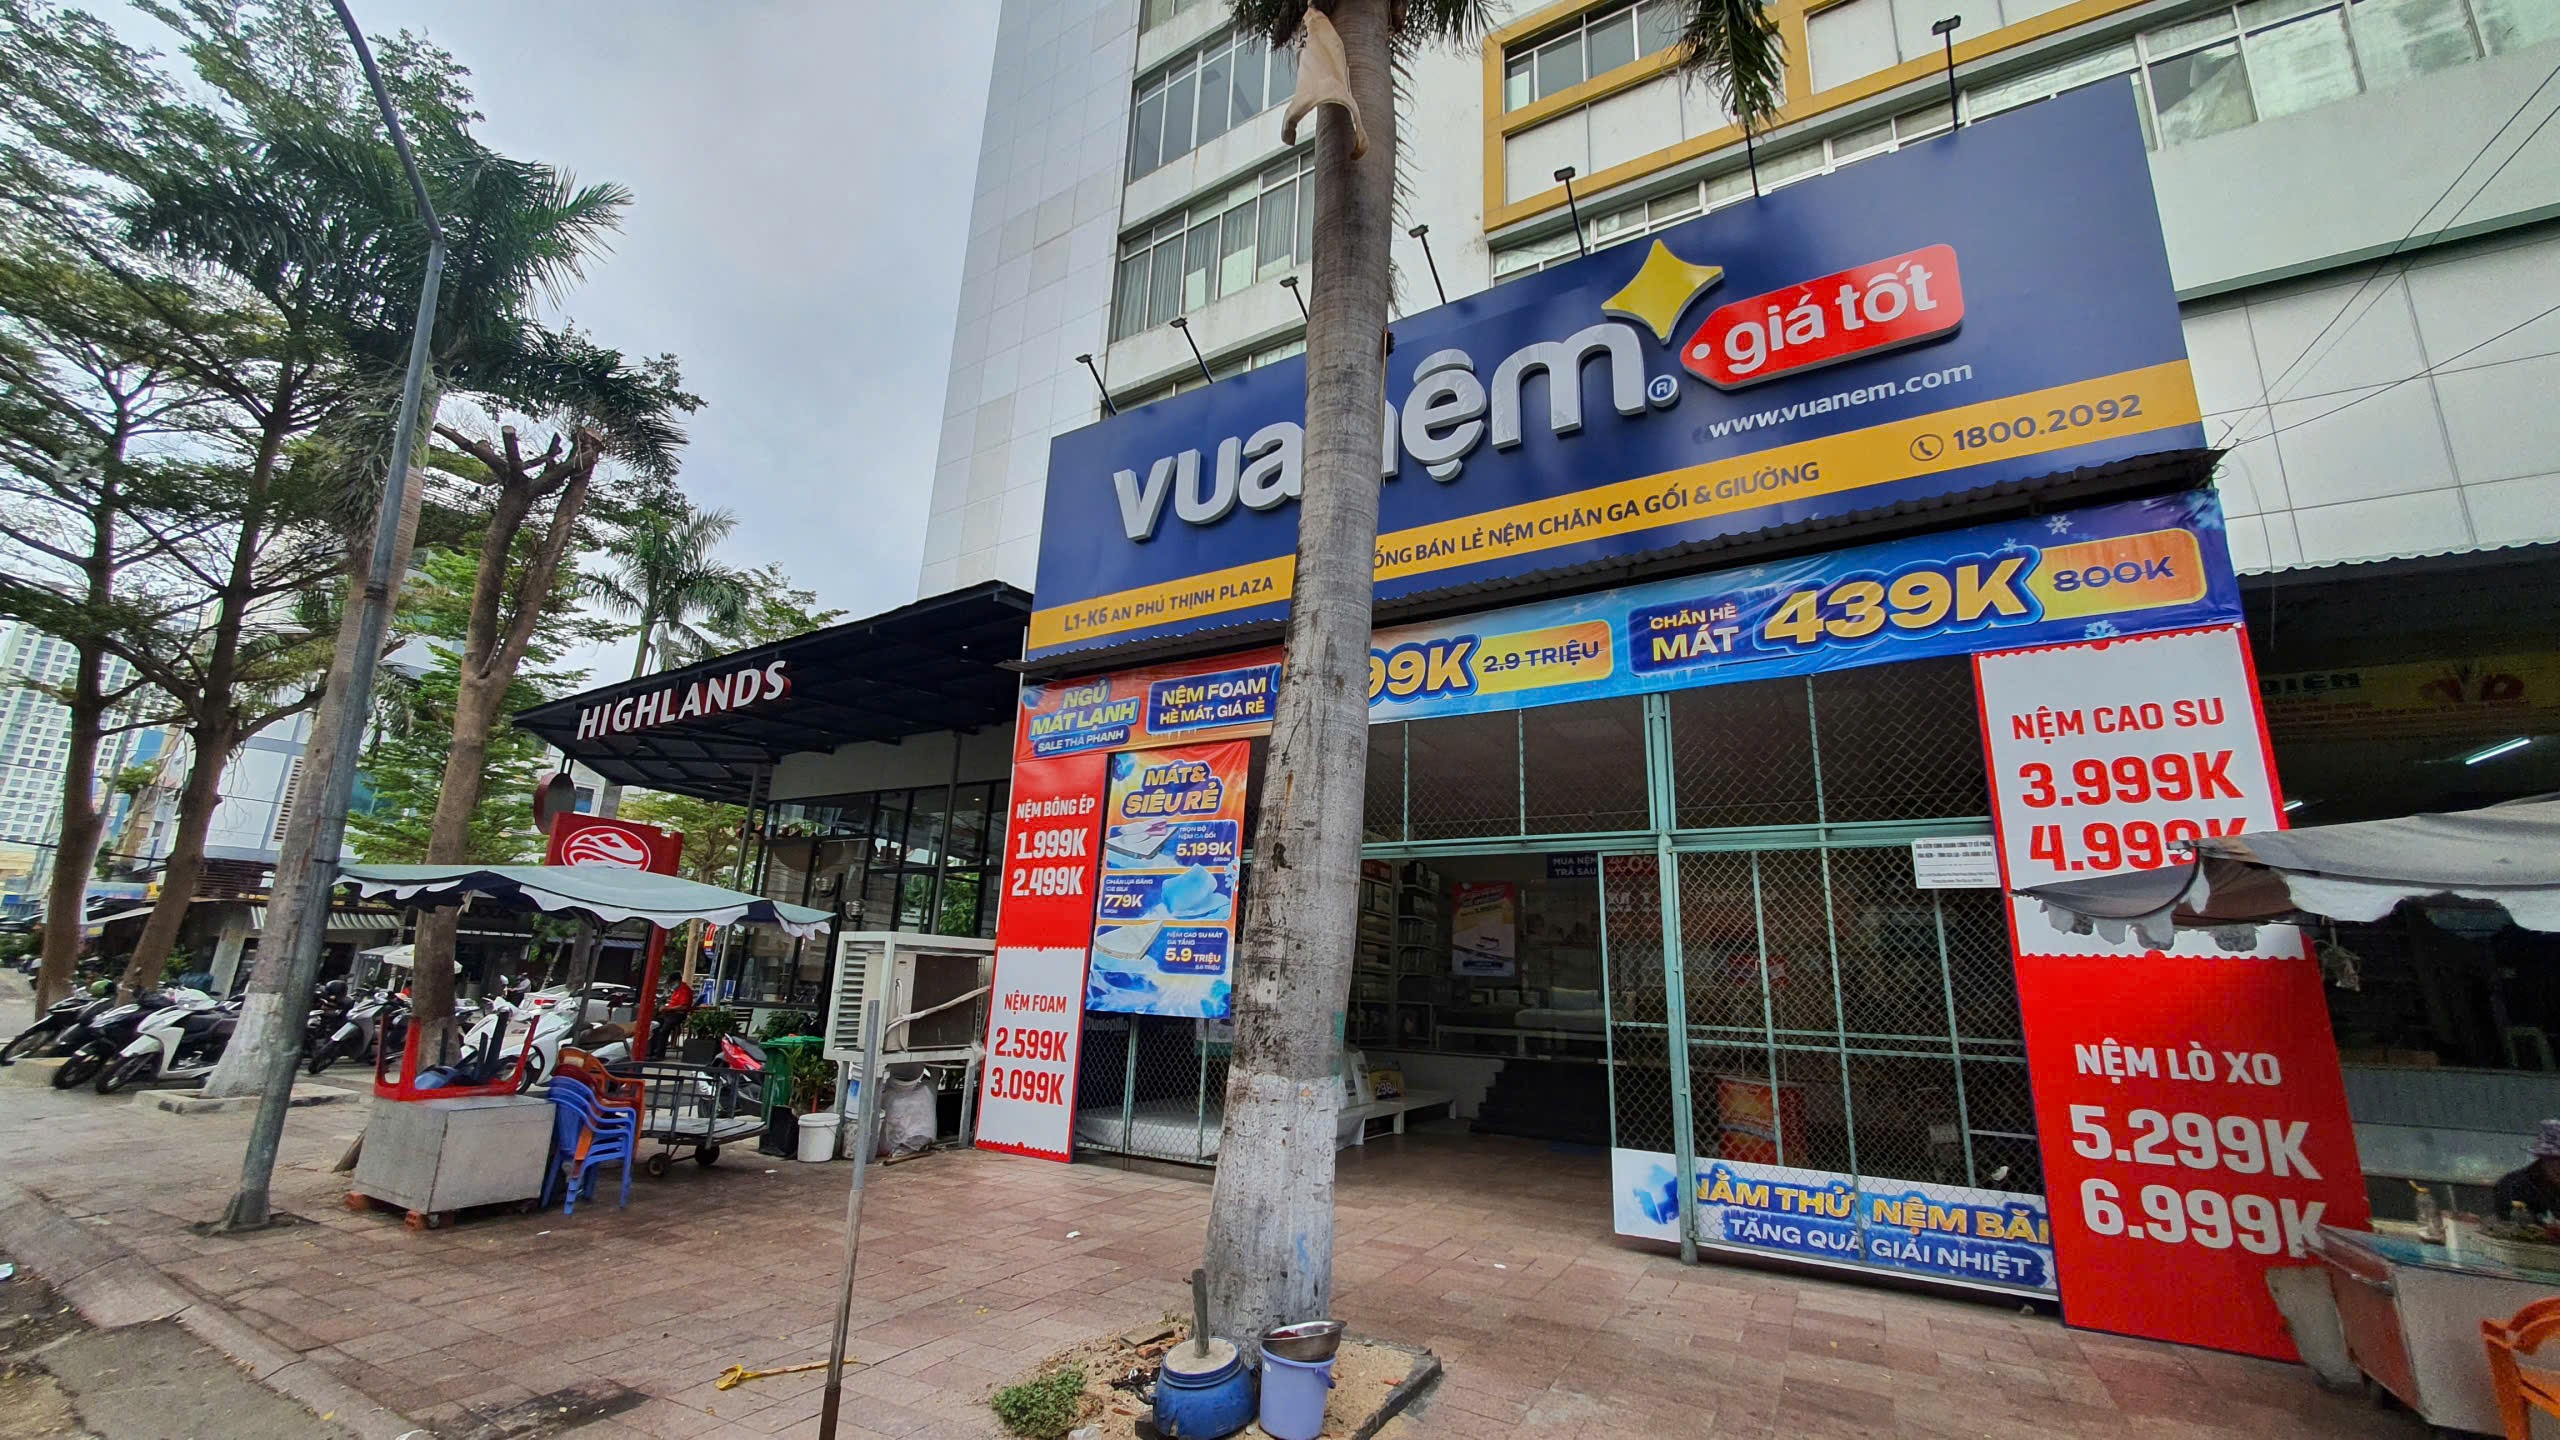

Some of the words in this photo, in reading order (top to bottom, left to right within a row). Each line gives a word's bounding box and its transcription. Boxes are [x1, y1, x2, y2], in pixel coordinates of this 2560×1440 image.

[1723, 291, 1826, 375] giá
[1837, 259, 1938, 331] tốt
[1708, 363, 1973, 440] www.vuanem.com
[1952, 394, 2143, 452] 1800.2092
[1415, 537, 1455, 561] BÁN
[1461, 526, 1484, 551] LẺ
[1488, 521, 1533, 546] NỆM
[1538, 504, 1602, 535] CHĂN
[1607, 502, 1640, 523] GA
[1644, 483, 1688, 513] GỐI
[1692, 484, 1712, 504] &
[1714, 461, 1820, 499] GIƯỜNG
[2053, 556, 2175, 594] 800K
[1063, 607, 1108, 632] L1-K6
[1111, 605, 1132, 622] AN
[1135, 595, 1165, 617] PHÚ
[1169, 588, 1215, 610] THỊNH
[1219, 576, 1274, 600] PLAZA
[1650, 609, 1707, 630] CHĂN
[1709, 603, 1737, 621] HÈ
[1764, 557, 2028, 645] 439K
[1483, 651, 1521, 673] 2.9
[1524, 639, 1600, 668] TRIỆU
[1651, 624, 1740, 662] MÁT
[576, 660, 788, 741] HIGHLANDS
[1160, 708, 1179, 725] HÈ
[1180, 704, 1215, 722] MÁT,
[1216, 699, 1243, 718] GIÁ
[1245, 696, 1266, 715] RẺ
[1161, 684, 1205, 709] NỆM
[1207, 677, 1267, 700] FOAM
[1031, 709, 1077, 737] MÁT
[1076, 700, 1136, 731] LẠNH
[2011, 705, 2085, 744] NỆM
[2093, 702, 2165, 734] CAO
[2173, 697, 2225, 728] SU
[1038, 739, 1064, 752] SALE
[1086, 729, 1124, 744] PHANH
[1125, 788, 1183, 815] SIÊU
[1183, 781, 1220, 811] RẺ
[2018, 749, 2245, 809] 3.999K
[1016, 798, 1042, 823] NỆM
[1043, 795, 1077, 817] BÔNG
[1078, 793, 1096, 815] ÉP
[1016, 828, 1088, 860] 1.999K
[1176, 841, 1233, 857] 5.199K
[1011, 866, 1085, 897] 2.499K
[1104, 893, 1144, 908] 779K
[1164, 947, 1192, 962] 5.9
[1193, 951, 1221, 965] TRIỆU
[1003, 989, 1030, 1015] NỆM
[1031, 994, 1068, 1013] FOAM
[994, 1026, 1069, 1063] 2.599K
[2074, 1036, 2159, 1084] NỆM
[2166, 1040, 2216, 1082] LÒ
[2222, 1051, 2282, 1086] XO
[990, 1066, 1065, 1106] 3.099K
[2069, 1103, 2324, 1180] 5.299K
[1774, 1185, 1856, 1218] THỬ
[1872, 1196, 1968, 1236] NỆM
[2080, 1177, 2327, 1260] 6.999K
[1729, 1216, 1801, 1243] TẶNG
[1870, 1236, 1930, 1264] GIẢI
[1937, 1250, 2032, 1279] NHIỆT
